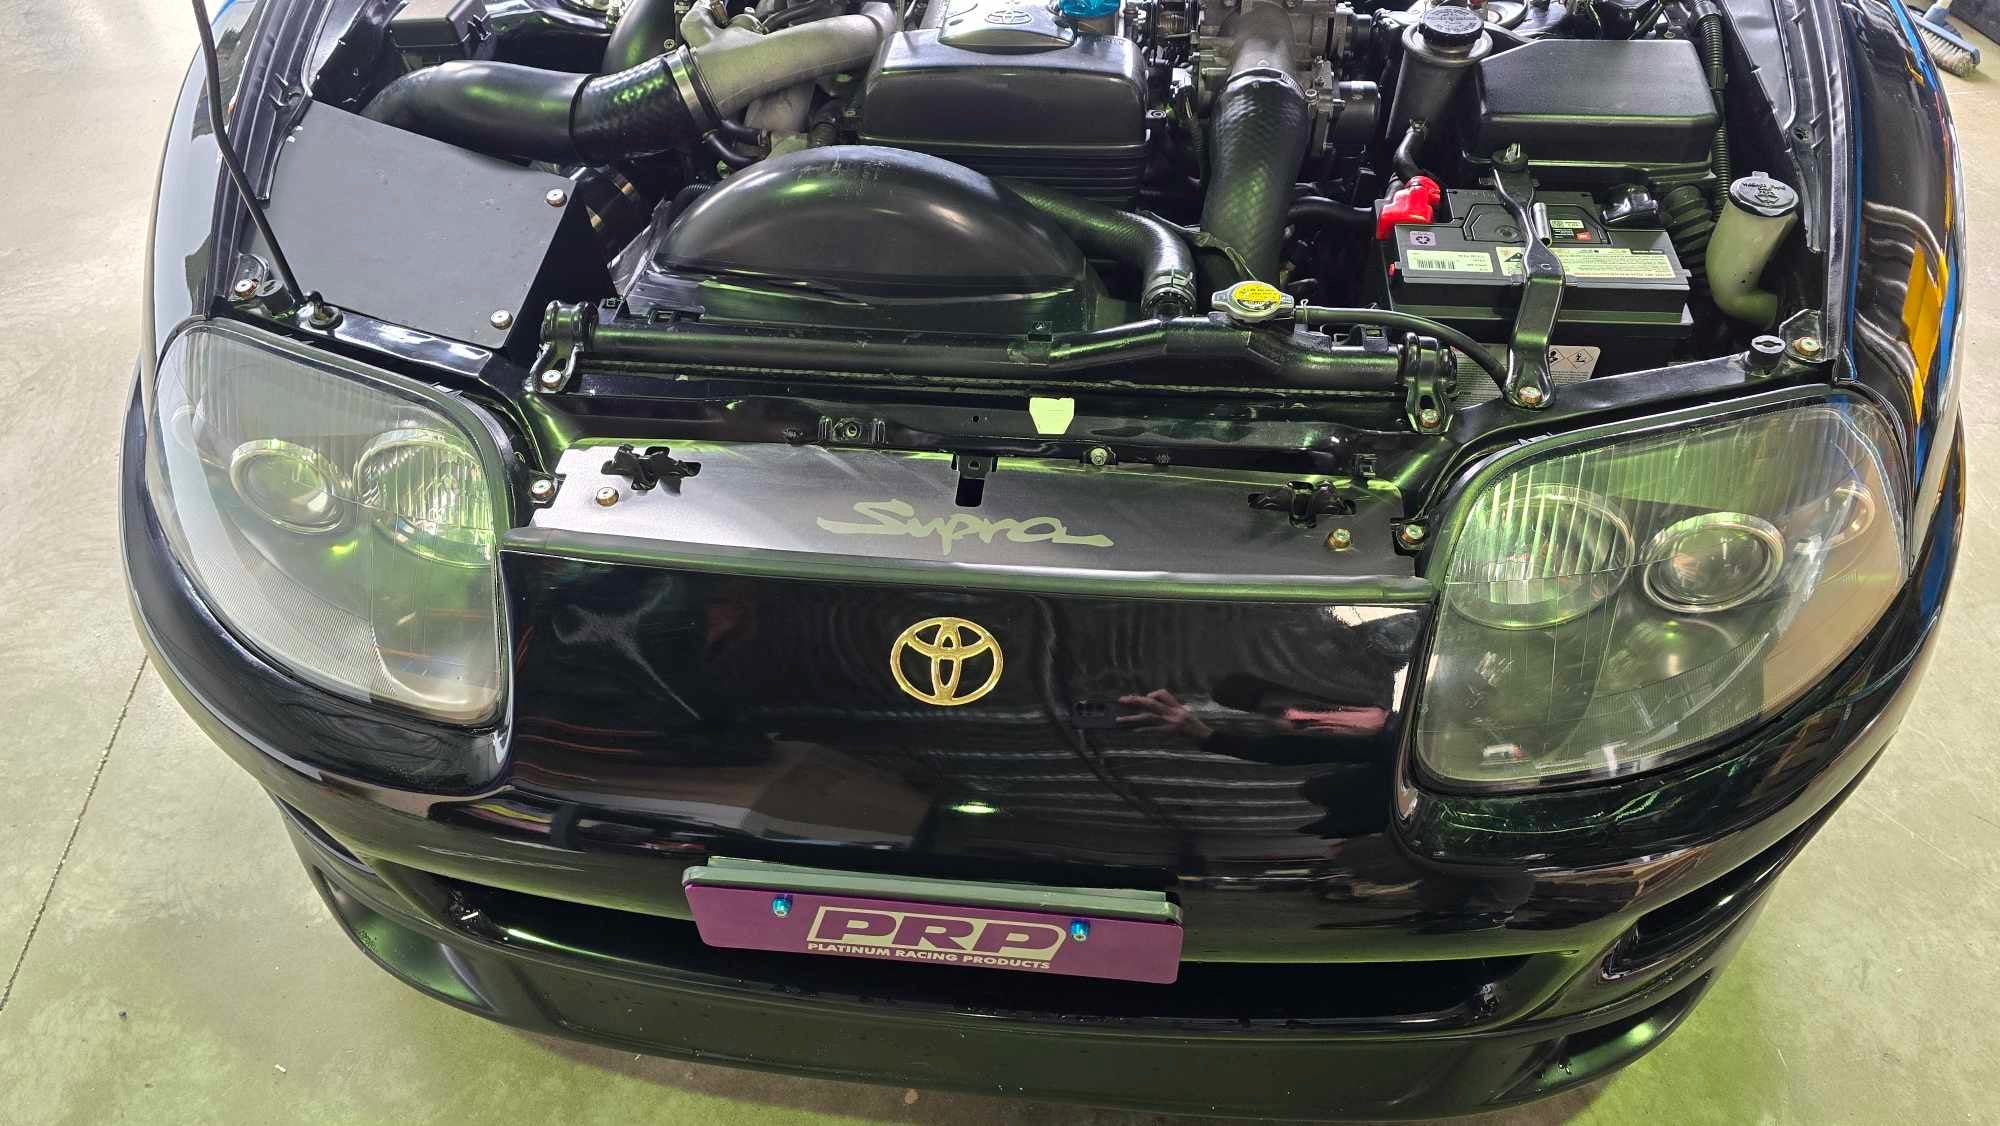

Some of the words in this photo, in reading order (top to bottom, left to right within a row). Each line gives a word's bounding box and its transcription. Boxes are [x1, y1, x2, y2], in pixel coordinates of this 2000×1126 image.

[816, 498, 1114, 556] Supra
[807, 942, 891, 957] PLATINUM
[895, 949, 958, 962] RACING
[962, 953, 1050, 970] PRODUCTS
[812, 908, 1063, 957] PRP
